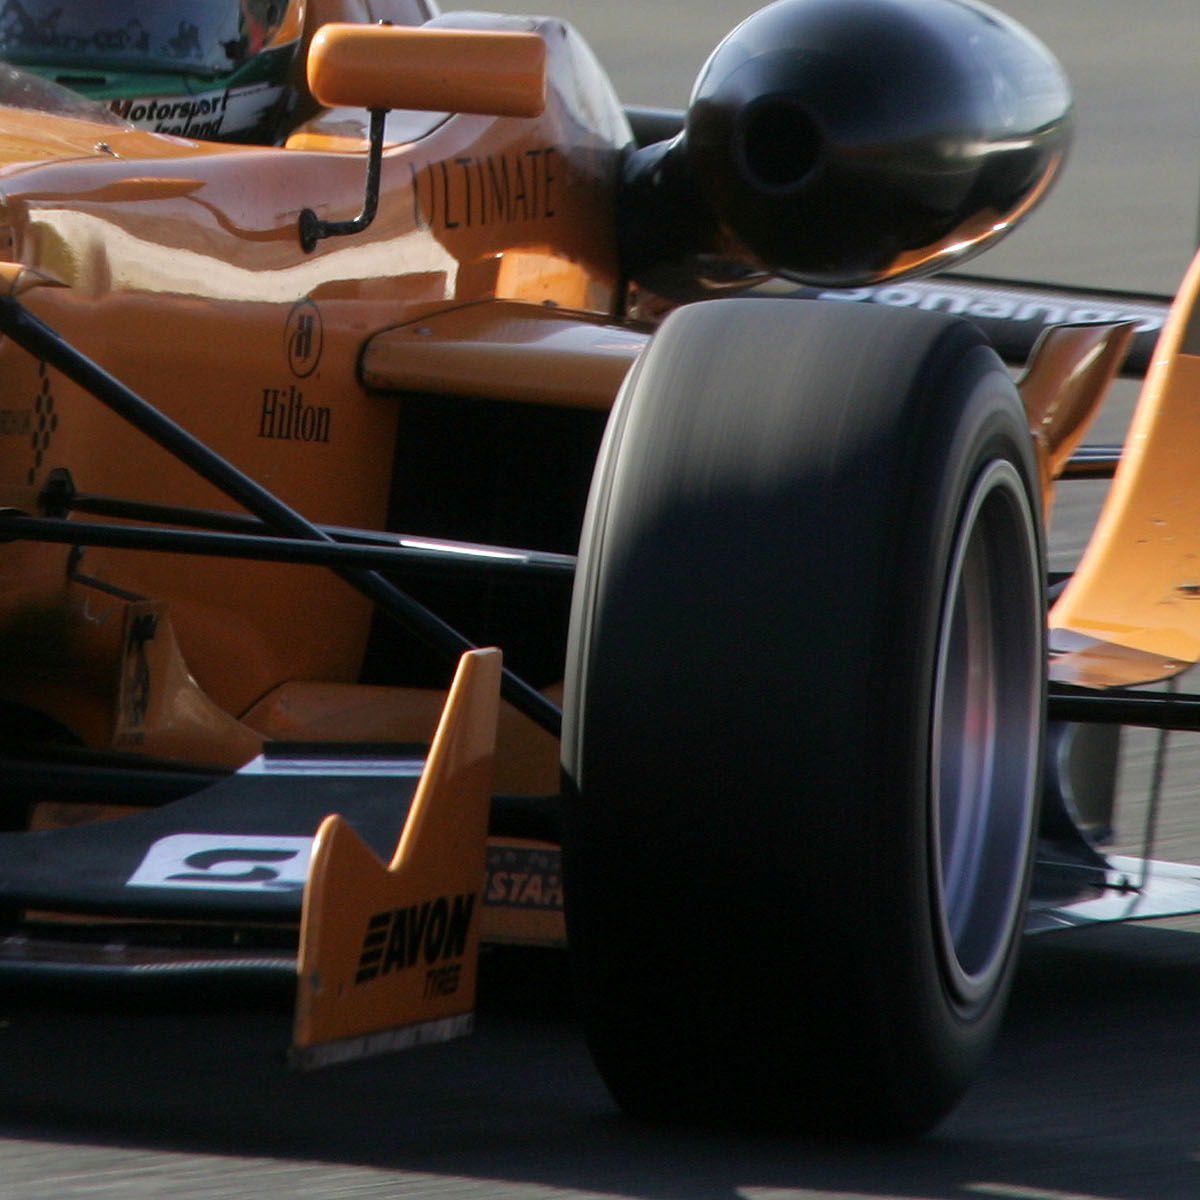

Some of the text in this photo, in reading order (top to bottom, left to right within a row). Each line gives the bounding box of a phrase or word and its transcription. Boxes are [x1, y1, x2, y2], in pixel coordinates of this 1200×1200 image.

[109, 88, 229, 121] Motorsport
[409, 146, 557, 230] ULTIMATE
[258, 385, 331, 443] Hilton
[380, 891, 477, 977] AVON
